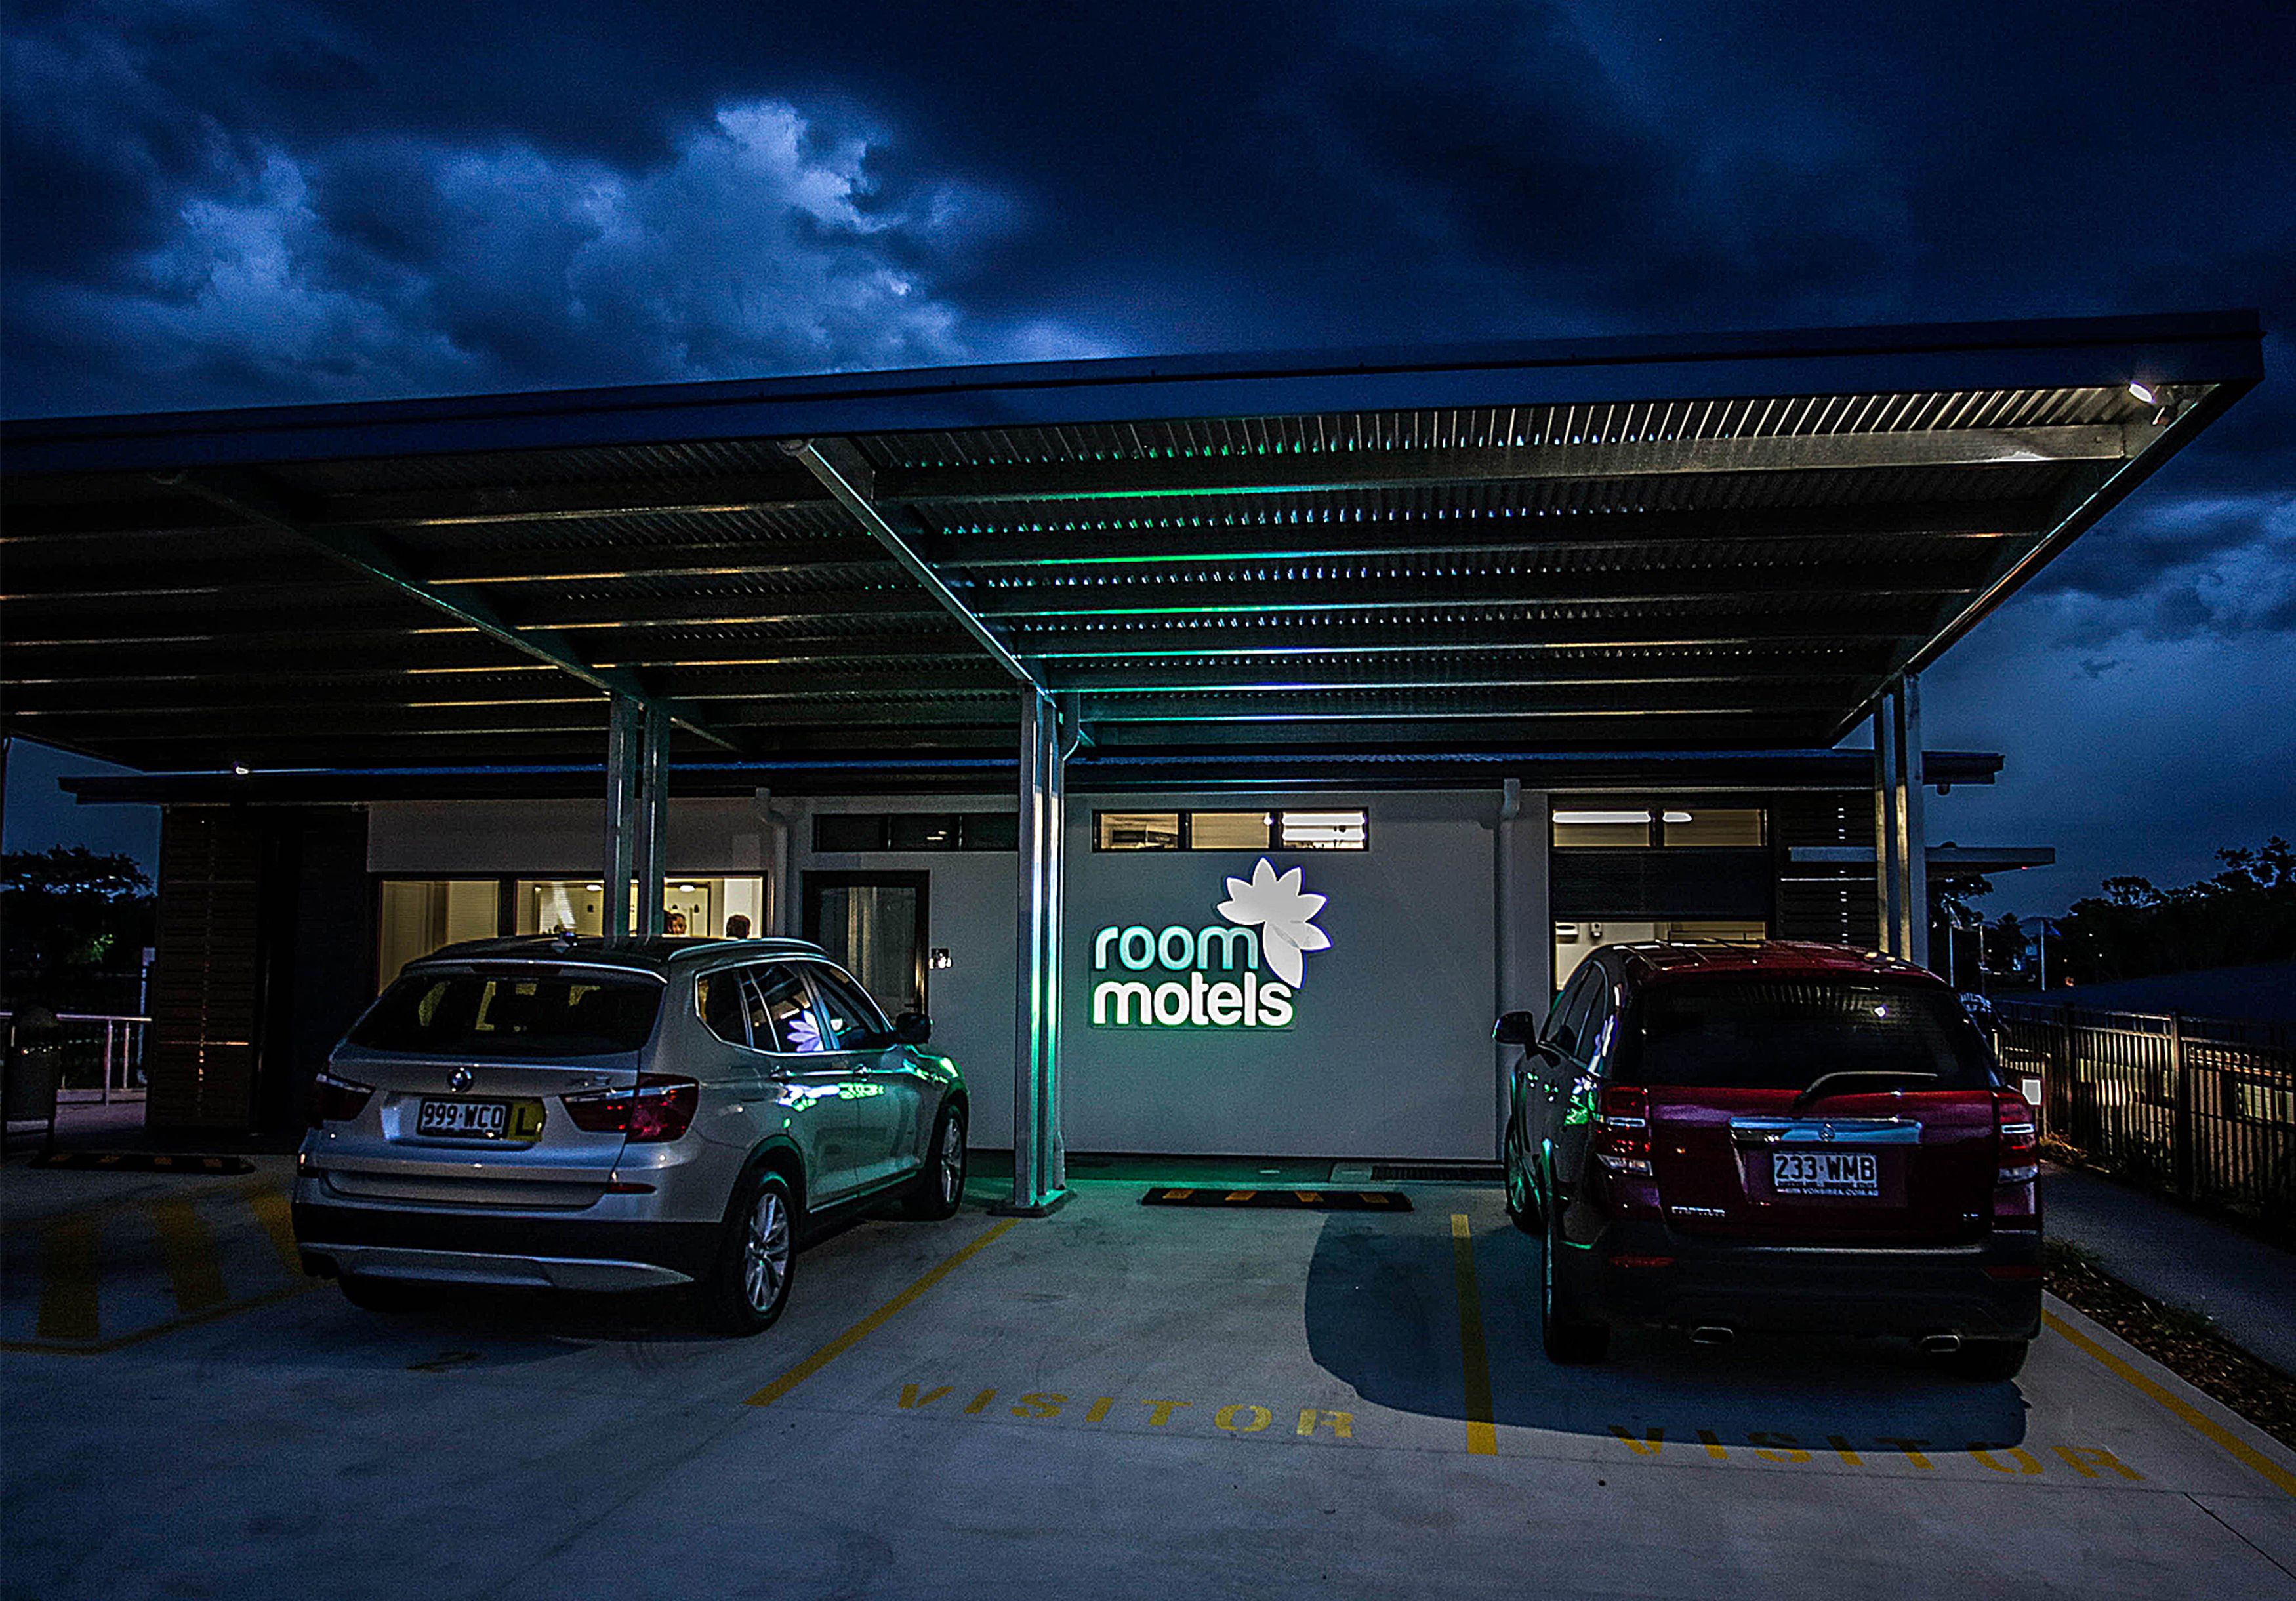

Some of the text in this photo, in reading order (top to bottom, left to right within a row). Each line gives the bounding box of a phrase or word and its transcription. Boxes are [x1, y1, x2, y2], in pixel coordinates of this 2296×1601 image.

[1095, 926, 1258, 970] room
[1093, 972, 1293, 1026] motels
[515, 1108, 537, 1136] L
[898, 1384, 1355, 1438] VISITOR
[1608, 1424, 2146, 1481] VISITOR
